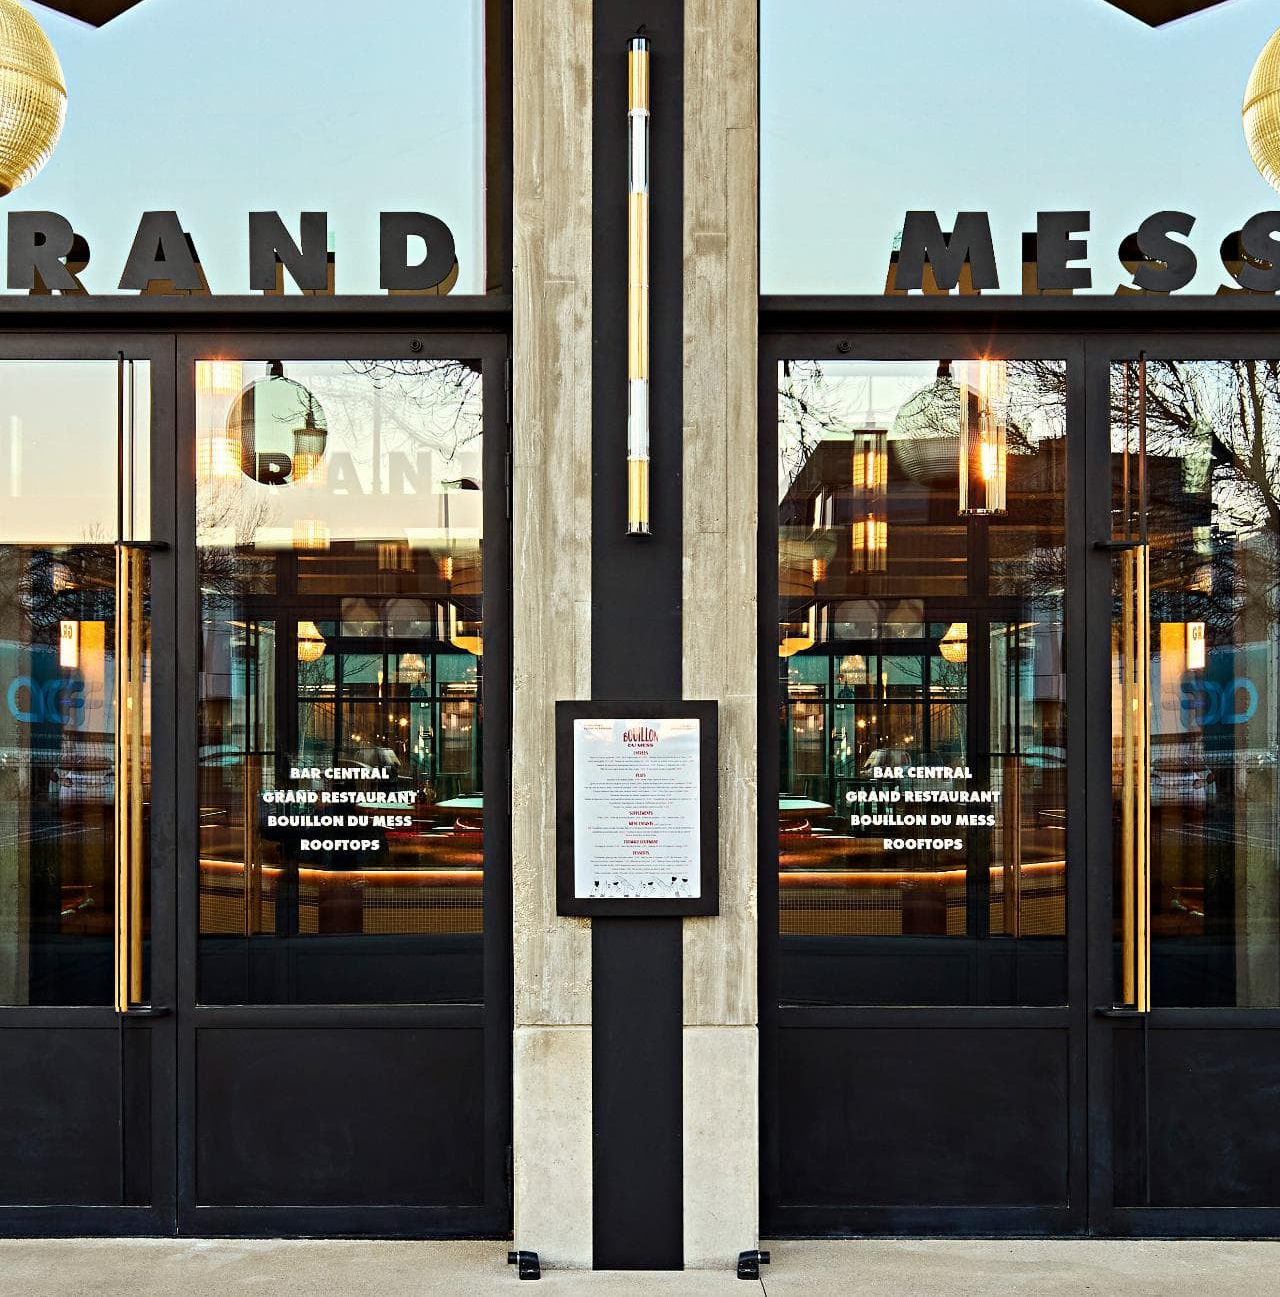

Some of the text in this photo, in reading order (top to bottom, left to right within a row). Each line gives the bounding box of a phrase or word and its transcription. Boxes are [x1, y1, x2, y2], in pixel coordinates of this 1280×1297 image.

[290, 767, 390, 779] BAR CENTRAL
[873, 766, 973, 779] BAR CENTRAL
[262, 791, 417, 804] GRAND RESTAURANT
[845, 790, 1001, 803] GRAND RESTAURANT
[267, 815, 413, 827] BOUILLON DU MESS
[850, 814, 996, 827] BOUILLON DU MESS
[300, 839, 380, 851] ROOFTOPS
[883, 838, 963, 850] ROOFTOPS
